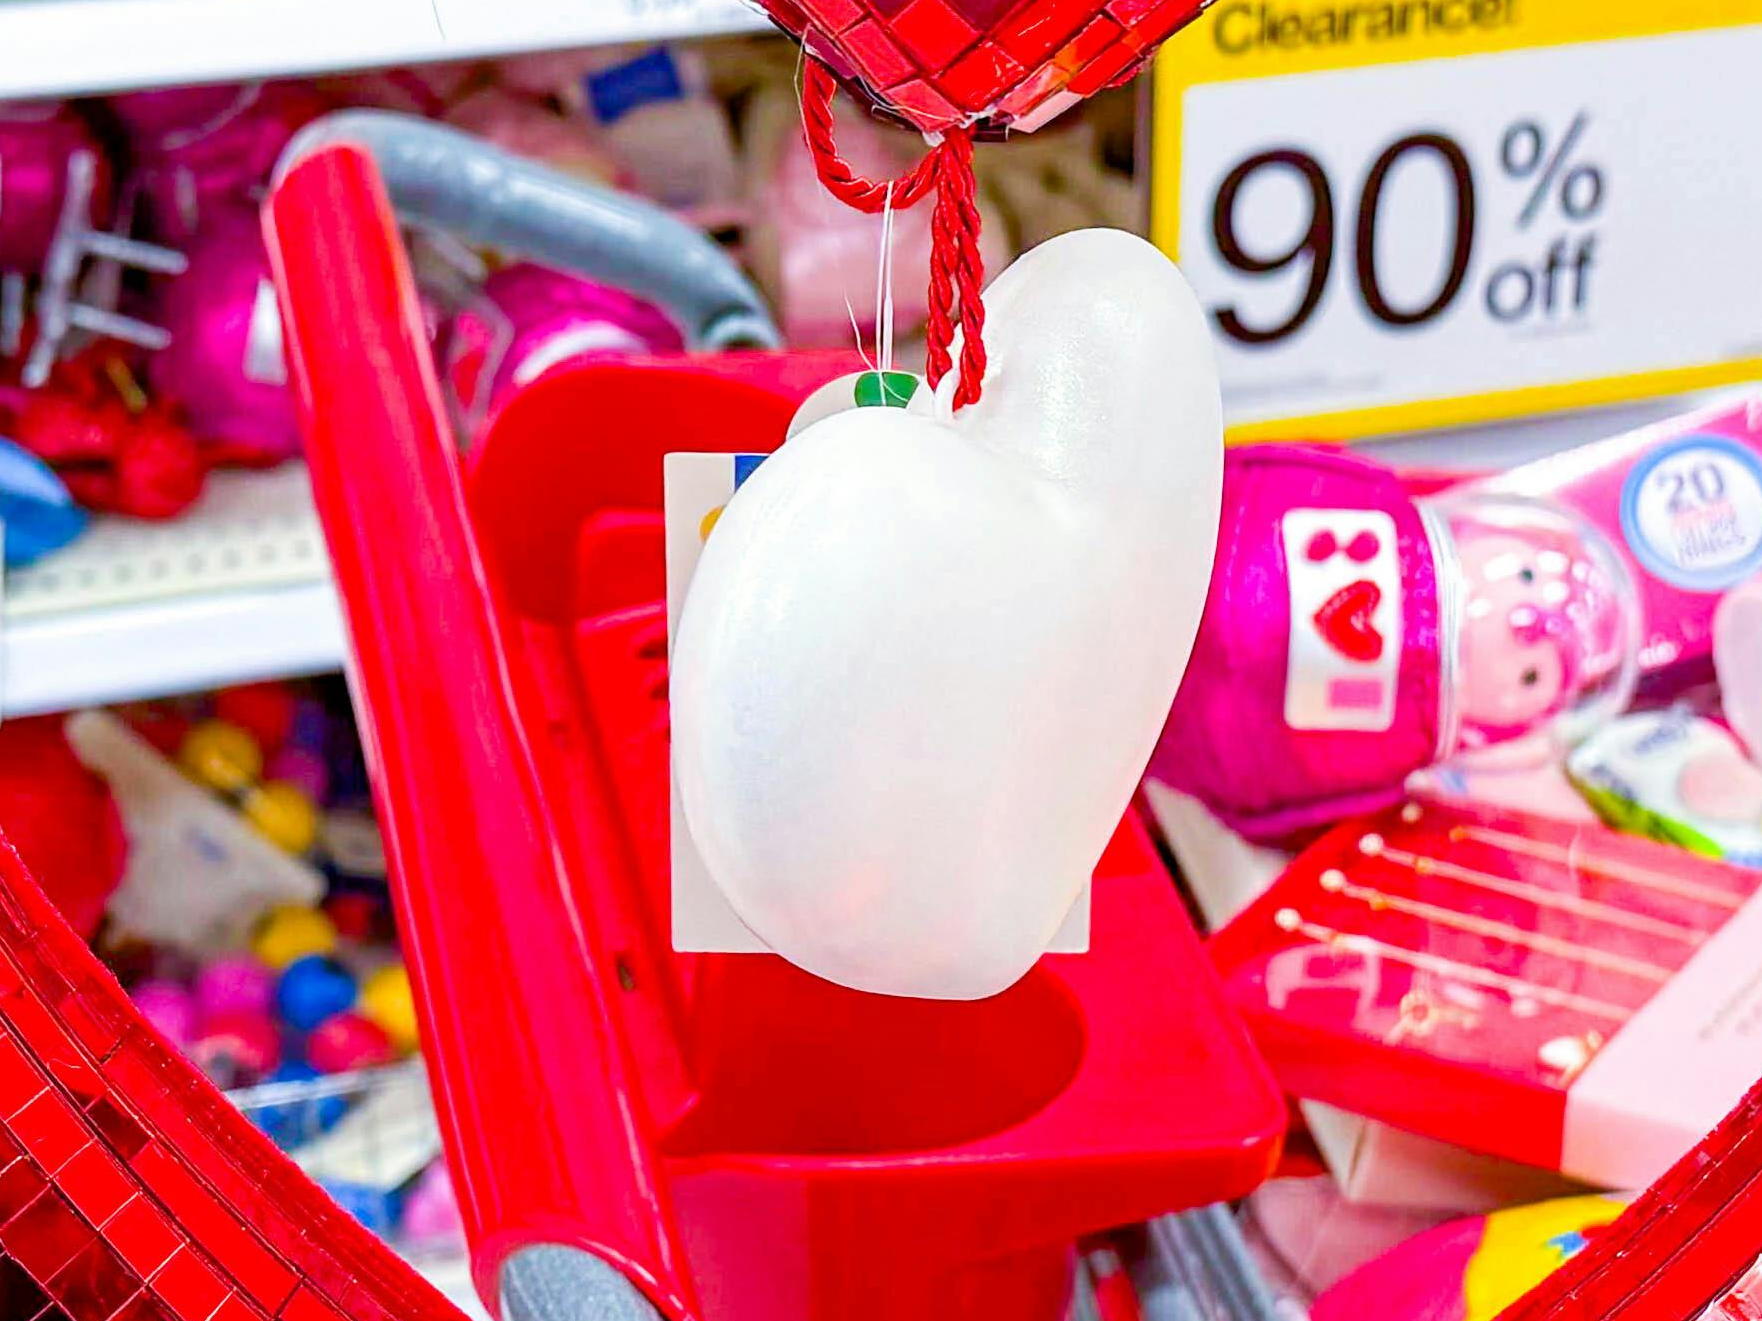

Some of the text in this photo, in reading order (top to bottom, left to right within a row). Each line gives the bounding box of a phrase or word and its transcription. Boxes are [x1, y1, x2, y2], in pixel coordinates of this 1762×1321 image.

[1208, 129, 1479, 347] 90
[1484, 235, 1600, 324] off
[1656, 462, 1727, 516] 20
